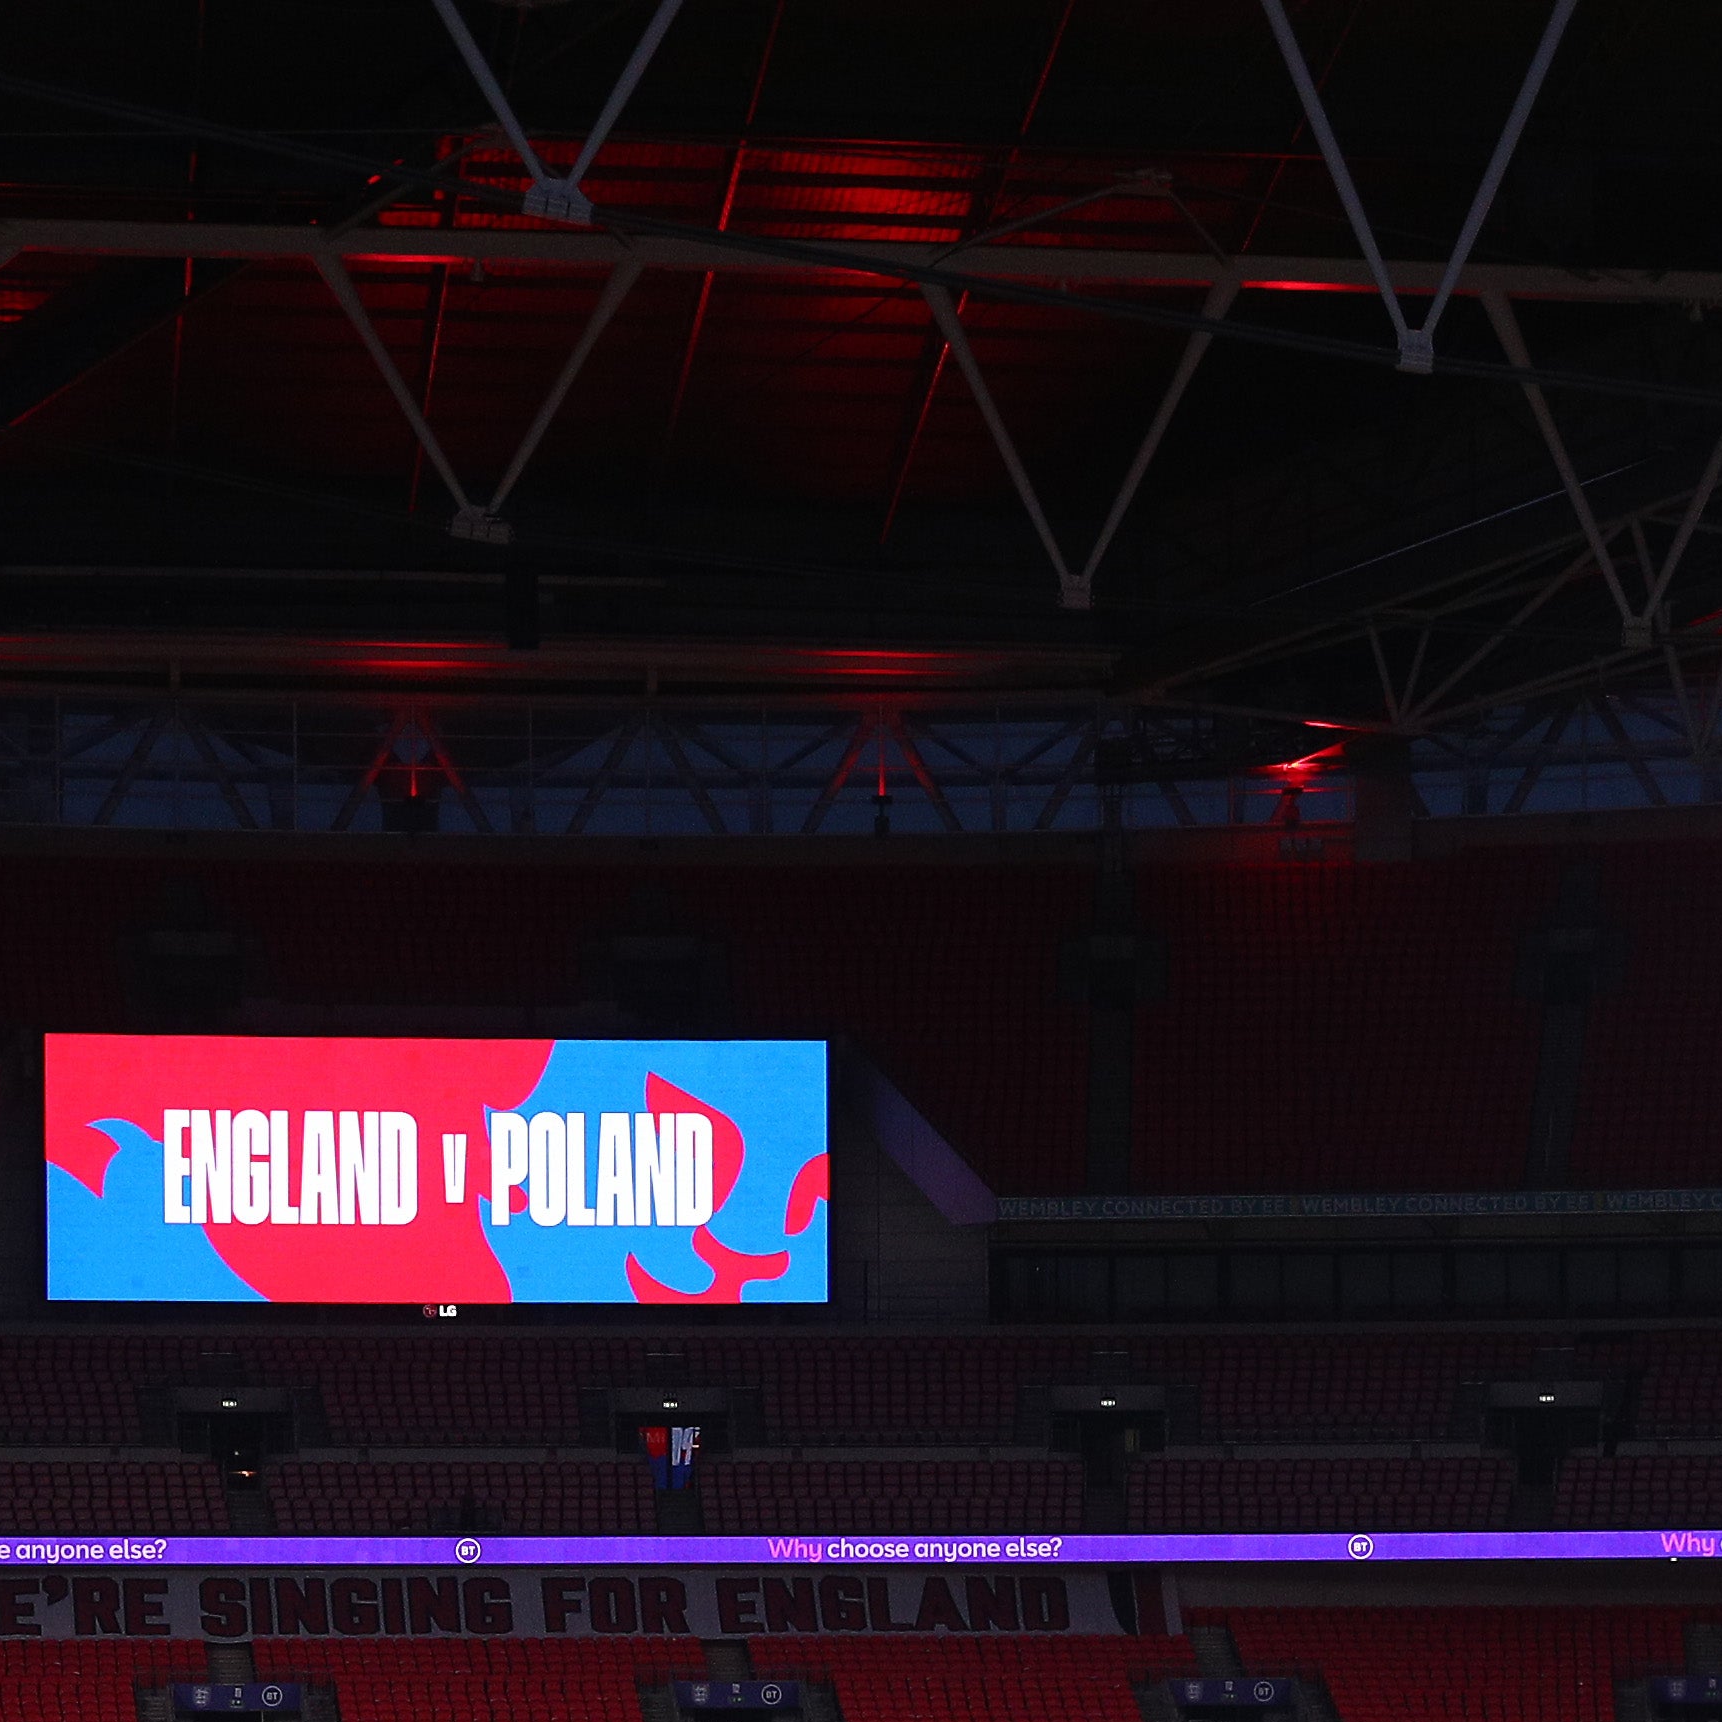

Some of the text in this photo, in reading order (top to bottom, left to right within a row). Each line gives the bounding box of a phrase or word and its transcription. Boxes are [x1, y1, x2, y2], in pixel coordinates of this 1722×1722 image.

[163, 1109, 418, 1226] ENGLAND
[490, 1112, 714, 1227] POLAND
[999, 1198, 1284, 1217] WEMBLEY CONNECTED BY EE
[1302, 1194, 1588, 1212] WEMBLEY CONNECTED BY EE
[1606, 1192, 1706, 1209] WEMBLEY
[439, 1304, 457, 1317] LG
[16, 1545, 104, 1564] anyone
[110, 1538, 166, 1559] else?
[461, 1545, 475, 1556] BT
[767, 1537, 1063, 1562] Why choose anyone else?
[1353, 1541, 1368, 1552] BT
[1661, 1533, 1715, 1557] Why
[199, 1577, 513, 1637] SINGING
[540, 1577, 690, 1635] FOR
[715, 1576, 1071, 1634] ENGLAND
